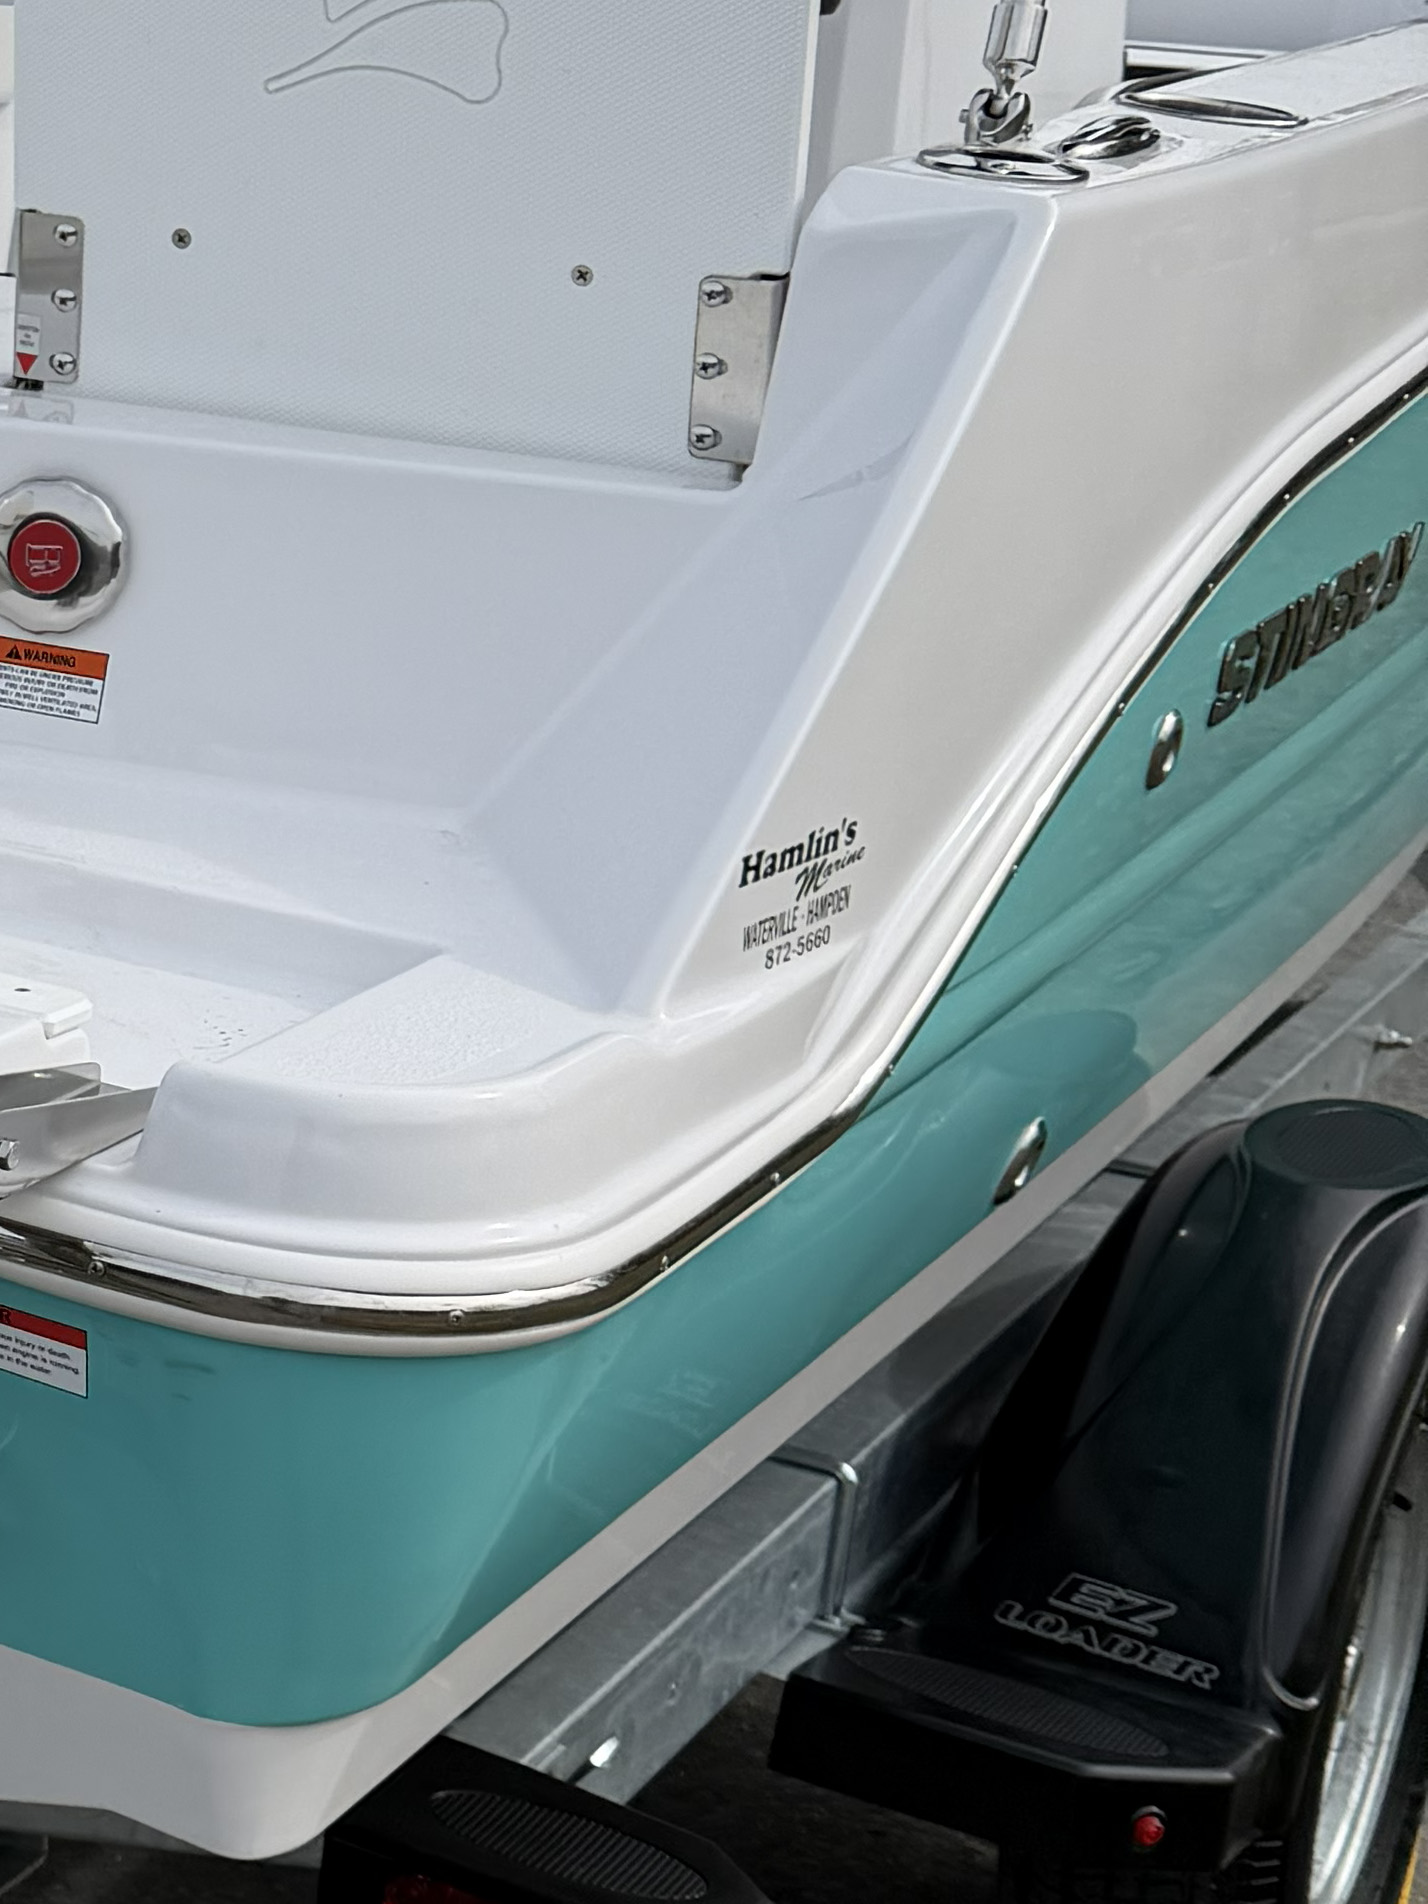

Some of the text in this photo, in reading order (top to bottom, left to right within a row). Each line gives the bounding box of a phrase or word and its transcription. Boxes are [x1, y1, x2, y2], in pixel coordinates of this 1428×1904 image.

[1207, 521, 1425, 727] STINGRAY
[22, 648, 76, 668] WARNING
[738, 817, 858, 888] Hamlin's
[795, 846, 865, 902] Marine
[743, 884, 851, 952] WATERVILLE HAMPDEN
[765, 925, 831, 969] 872-5660
[1048, 1572, 1178, 1637] EZ
[994, 1600, 1221, 1691] LOADER
